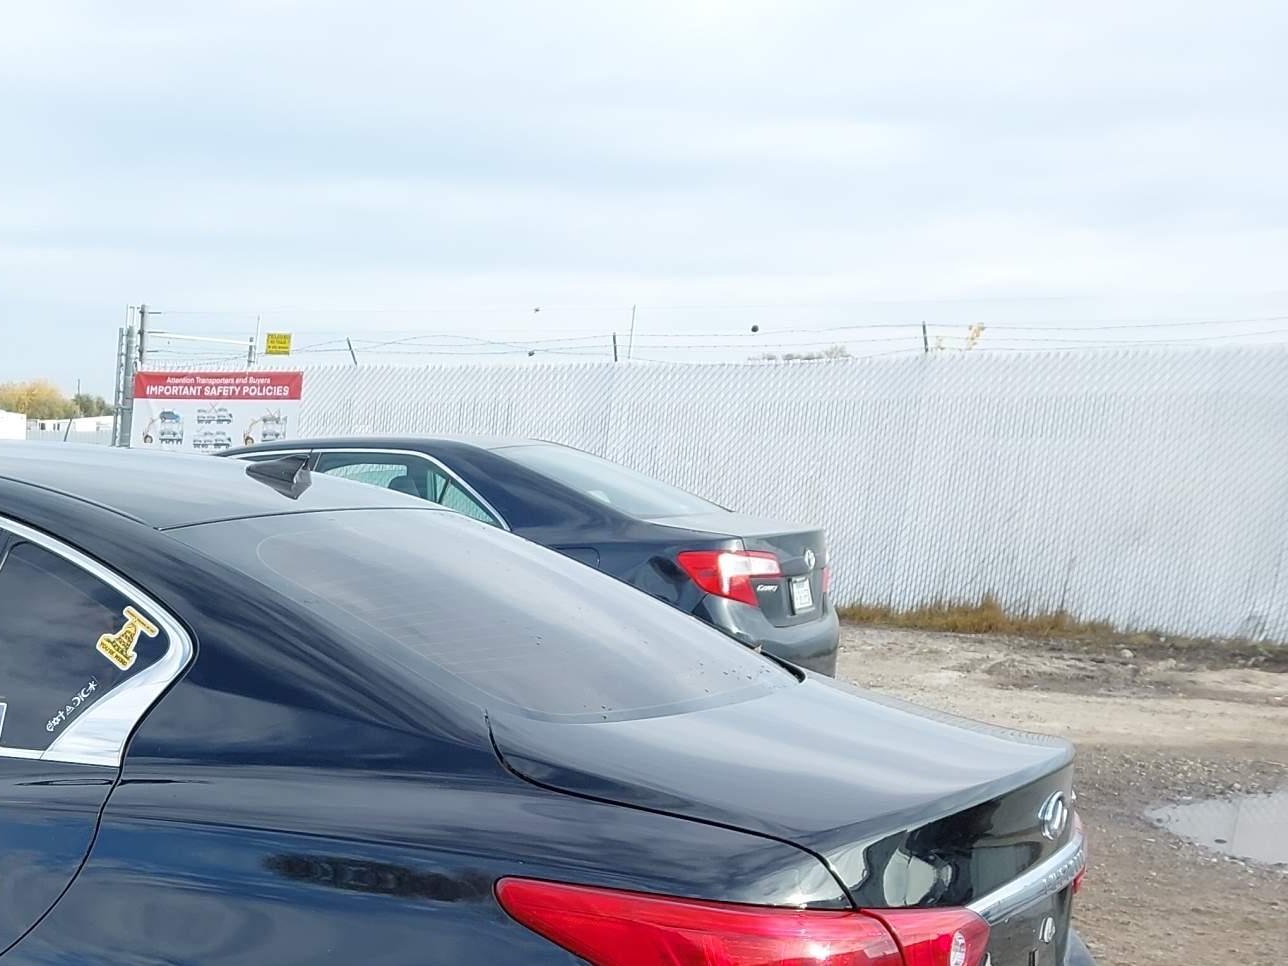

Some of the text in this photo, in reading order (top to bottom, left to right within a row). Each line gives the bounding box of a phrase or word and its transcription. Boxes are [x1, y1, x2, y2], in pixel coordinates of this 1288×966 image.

[196, 377, 234, 386] Transporters
[235, 377, 248, 385] and
[249, 377, 271, 386] Buyers
[146, 385, 290, 396] IMPORTANT SAFETY POLICIES
